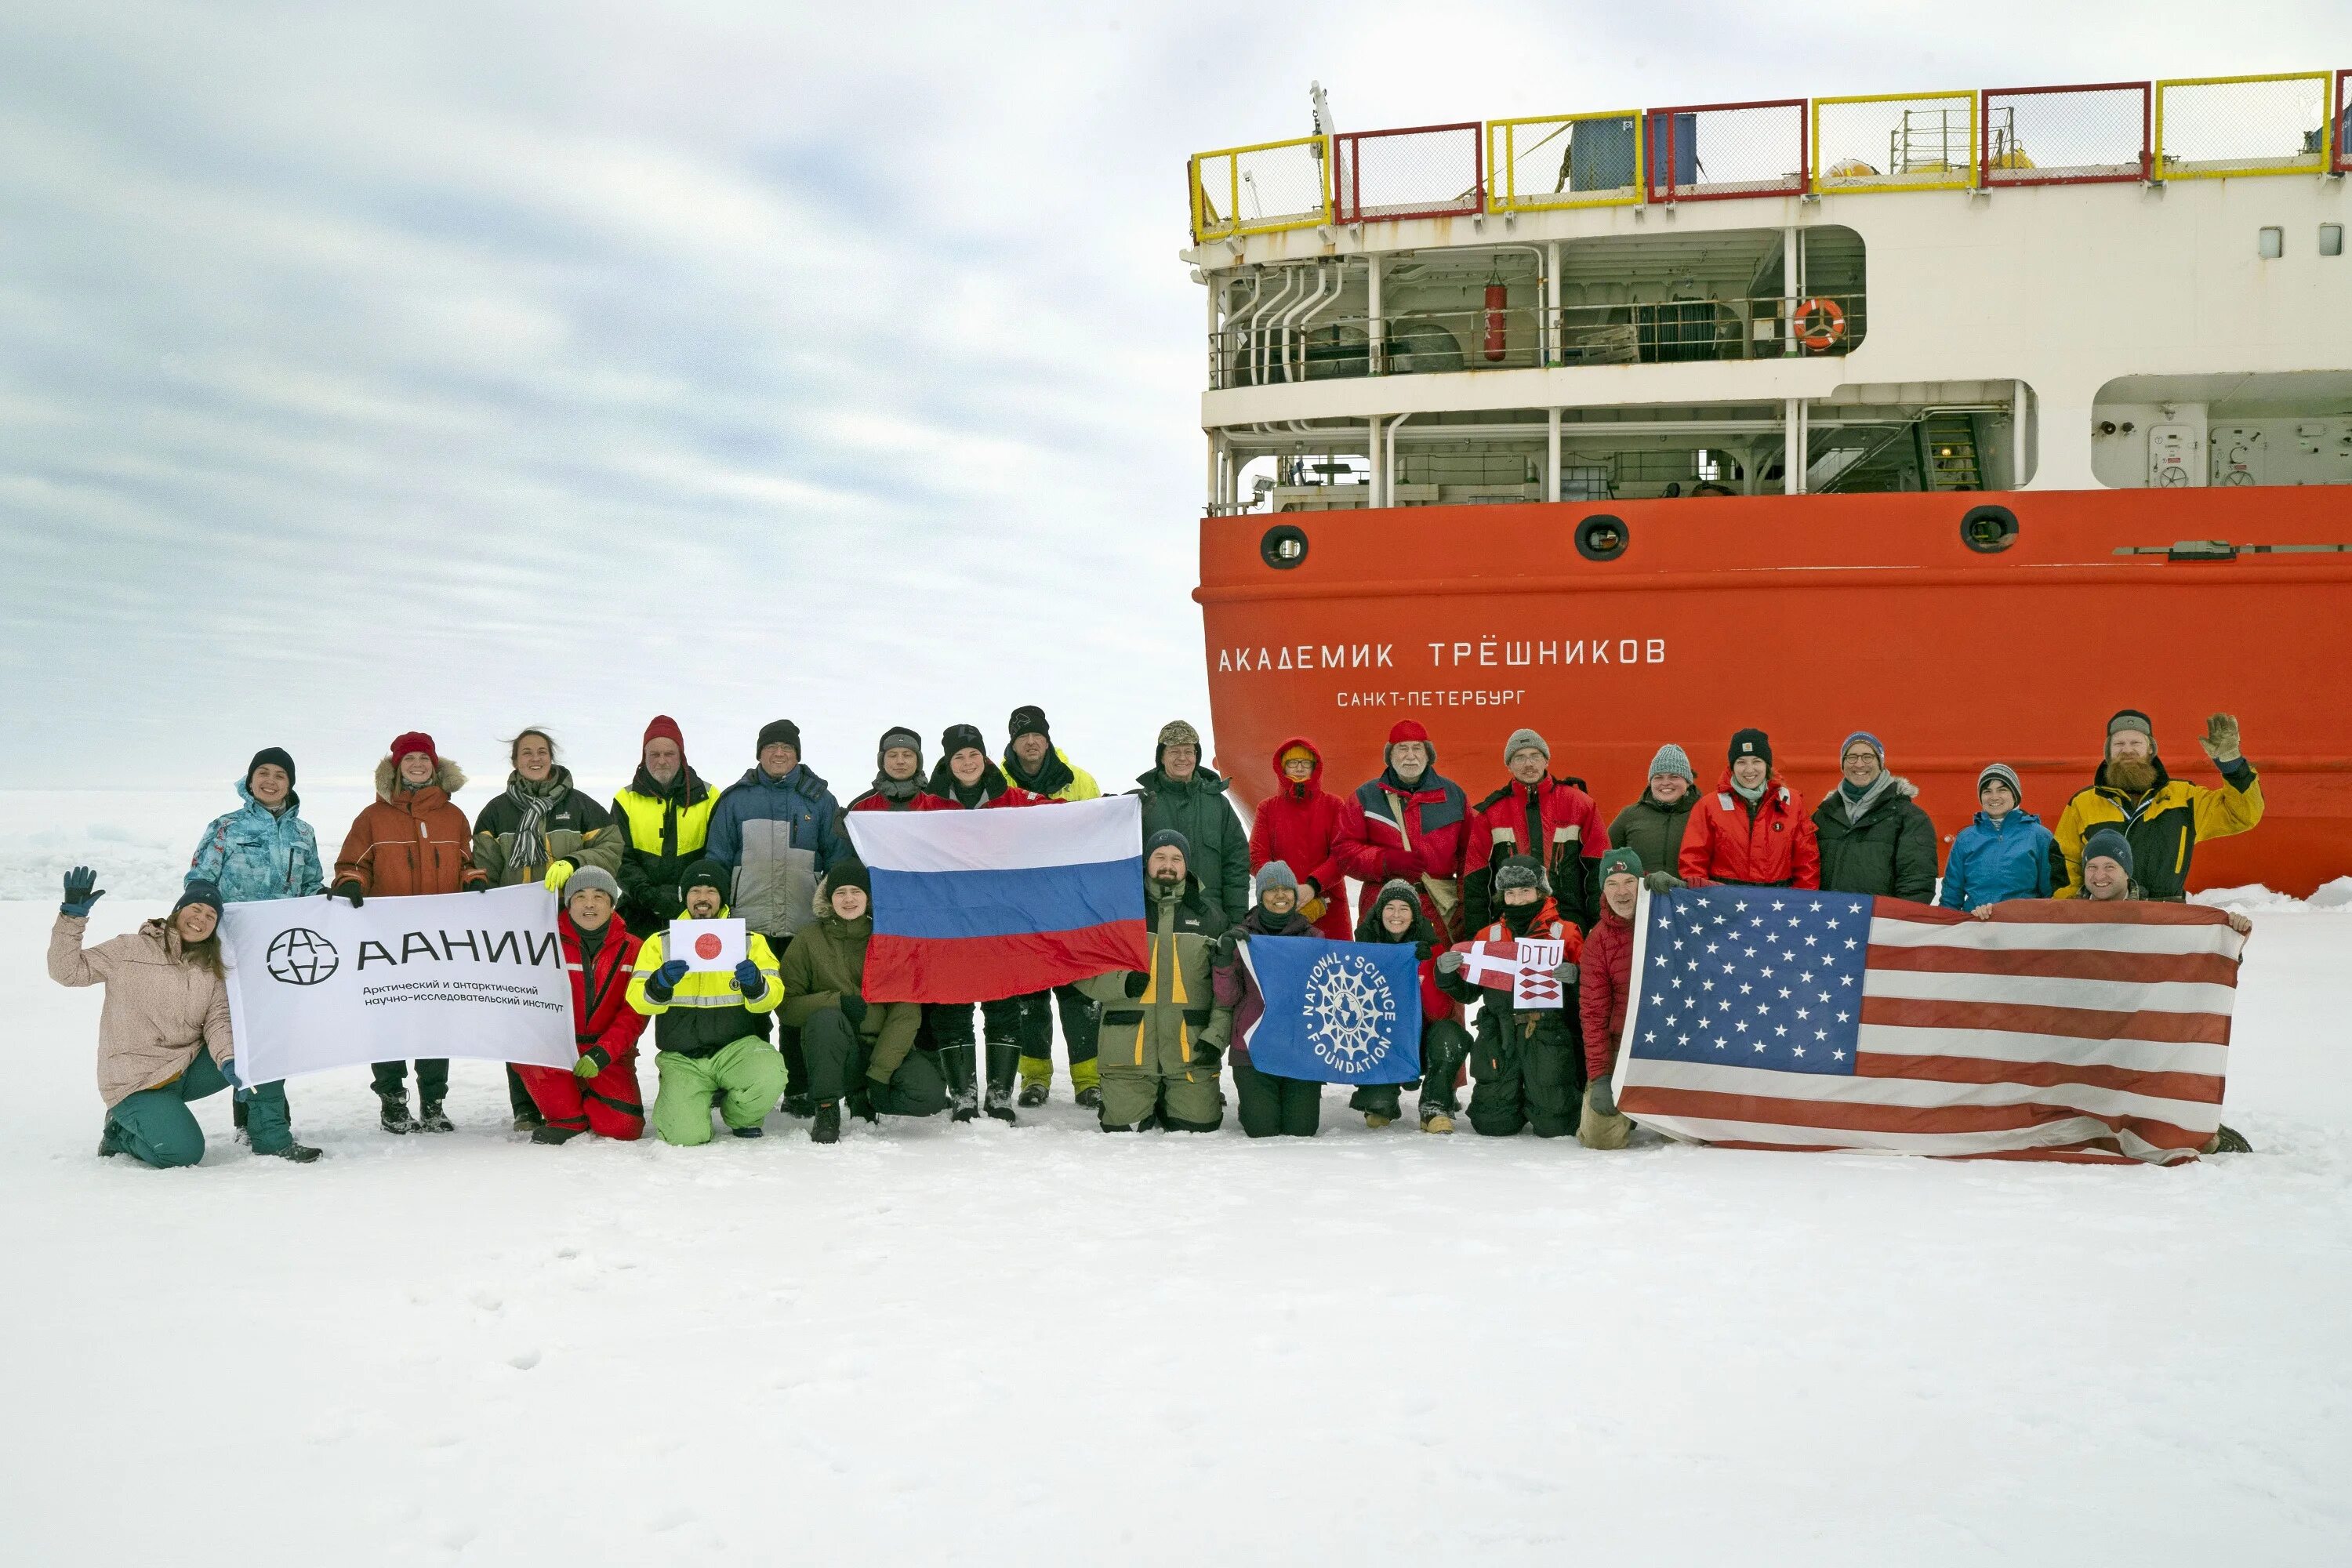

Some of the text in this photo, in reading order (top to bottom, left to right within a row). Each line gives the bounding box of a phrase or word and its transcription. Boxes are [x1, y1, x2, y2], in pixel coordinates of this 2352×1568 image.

[1218, 634, 1665, 672] АКАДЕМИК ТРЁШНИКОВ
[1338, 690, 1526, 707] САНКТ-ПЕТЕРБУРГ
[357, 929, 562, 971] ААНИИ
[1521, 944, 1560, 967] DTU
[363, 979, 440, 996] Арктический
[452, 982, 539, 995] антарктический
[1302, 952, 1396, 1022] NATIONAL SCIENCE
[365, 993, 564, 1014] научно-исследовательский институт
[1307, 1032, 1392, 1074] FOUNDATION
